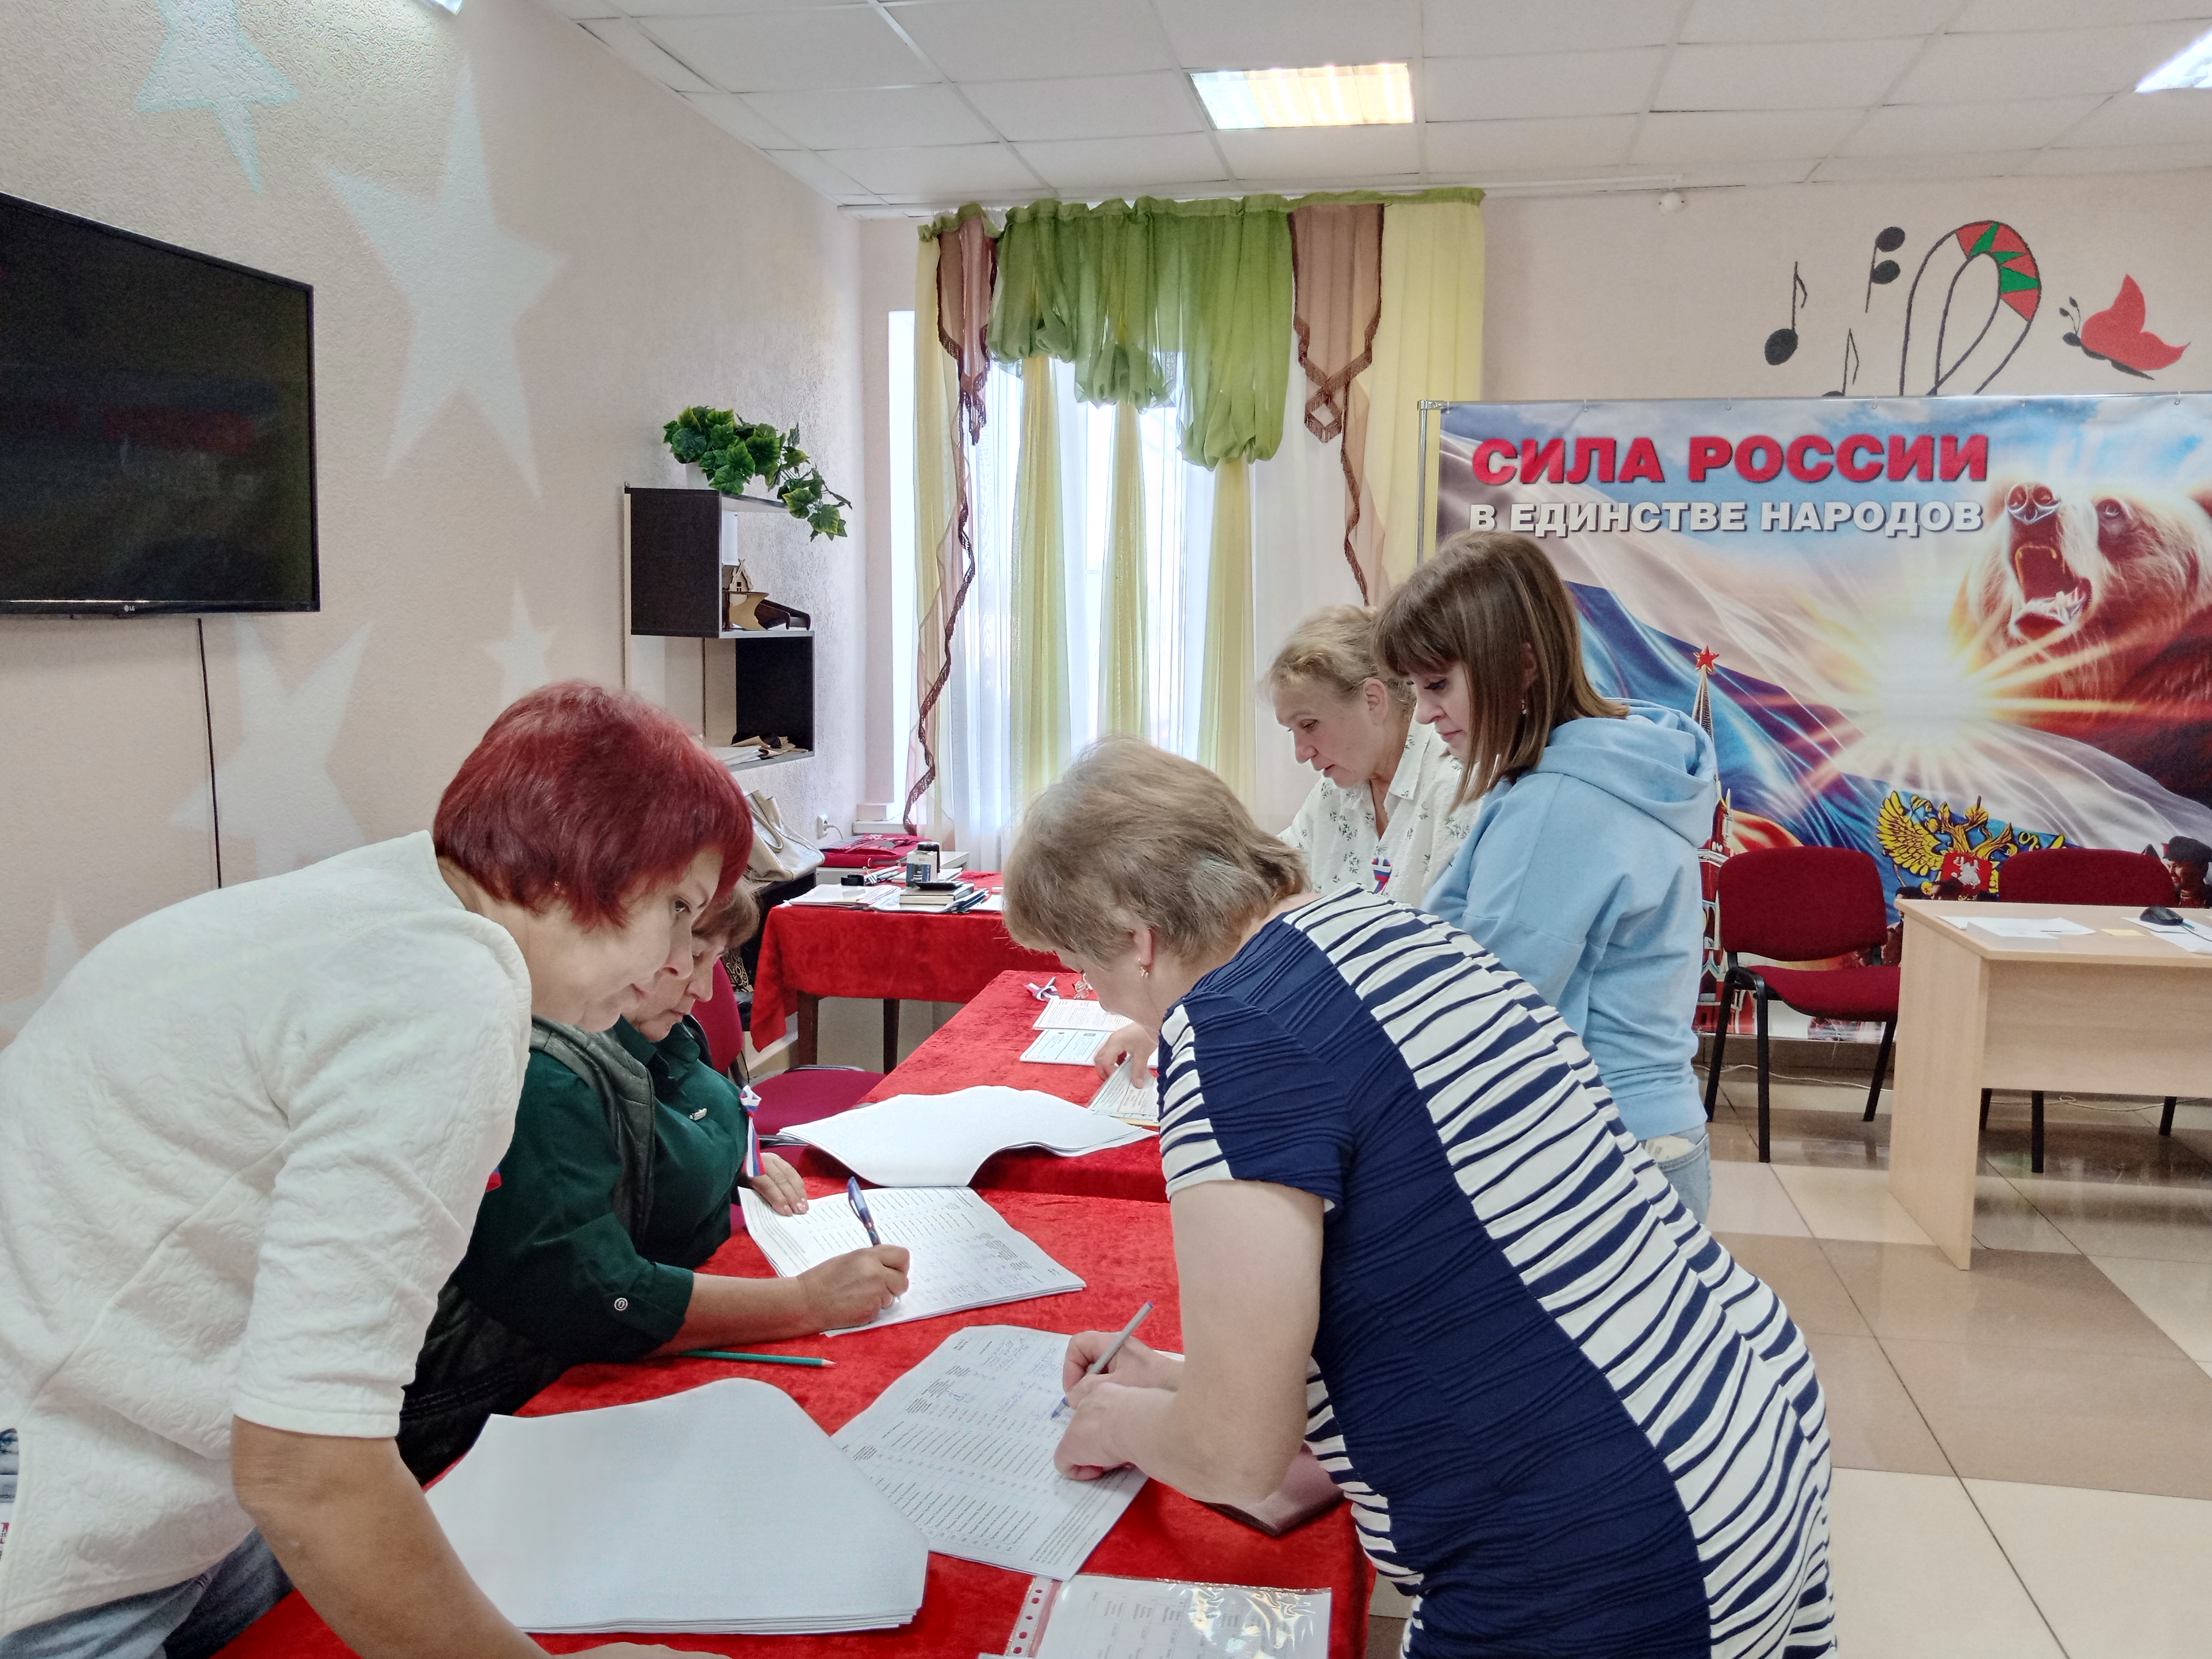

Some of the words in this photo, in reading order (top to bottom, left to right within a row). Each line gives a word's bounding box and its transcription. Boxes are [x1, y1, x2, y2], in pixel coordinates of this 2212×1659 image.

[1472, 436, 1665, 485] СИЛА
[1688, 434, 1988, 482] РОССИИ
[1469, 504, 1497, 531] В
[1510, 502, 1747, 538] ЕДИНСТВЕ
[1760, 500, 1984, 538] НАРОДОВ
